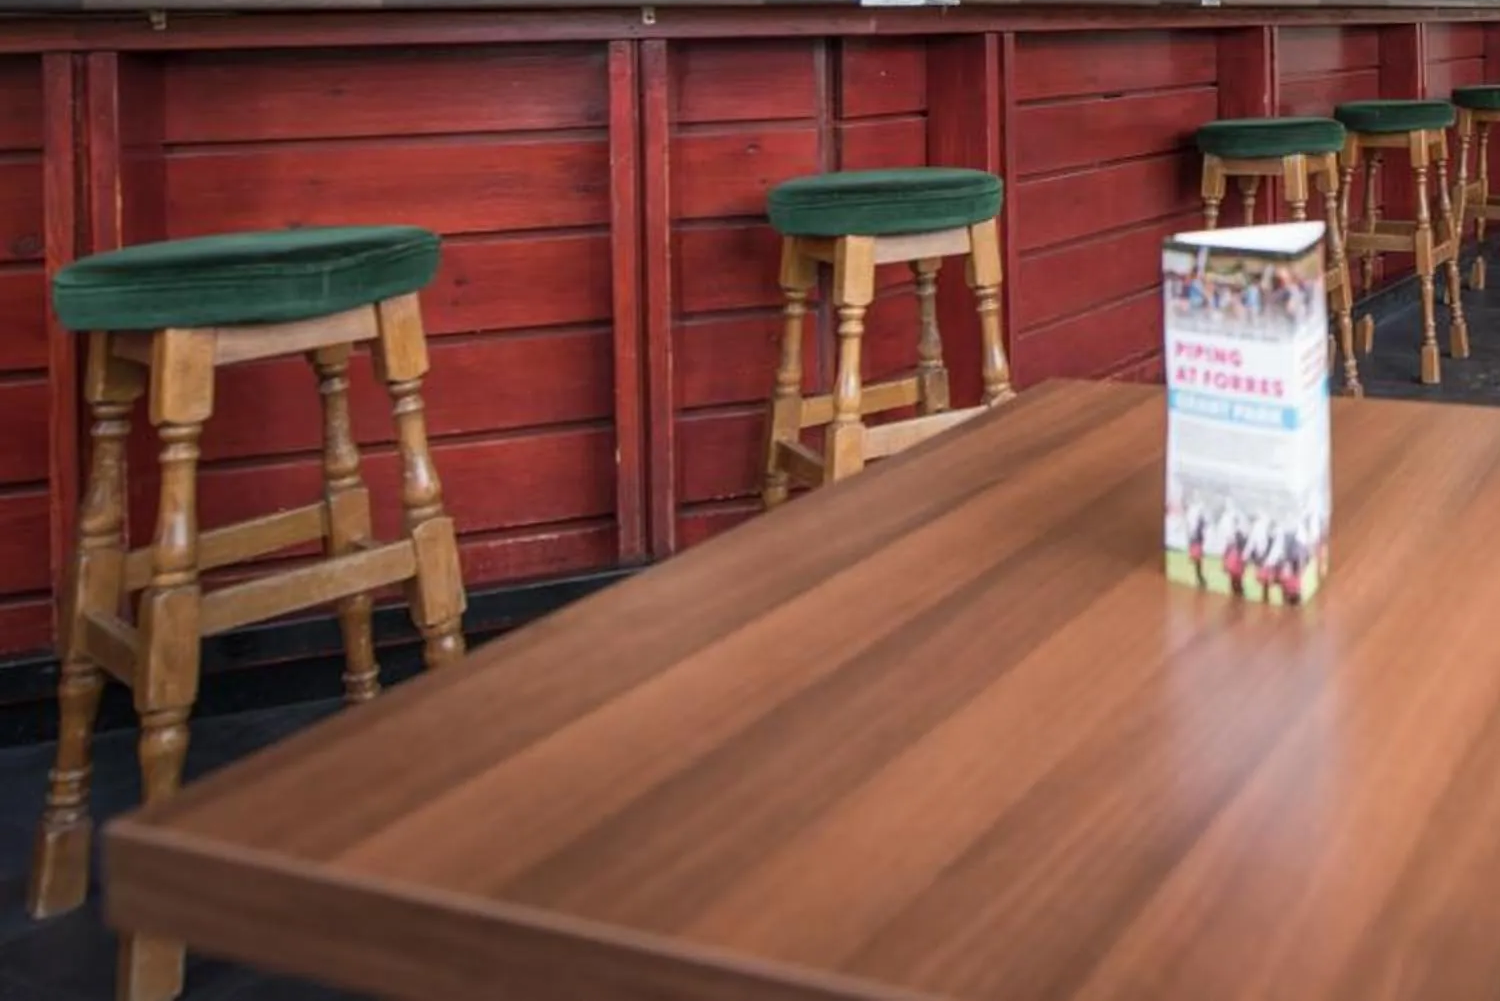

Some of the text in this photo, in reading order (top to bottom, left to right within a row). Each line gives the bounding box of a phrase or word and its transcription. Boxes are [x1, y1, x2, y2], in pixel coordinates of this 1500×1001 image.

[1174, 340, 1243, 367] PIPING
[1175, 366, 1285, 397] AT FORRES
